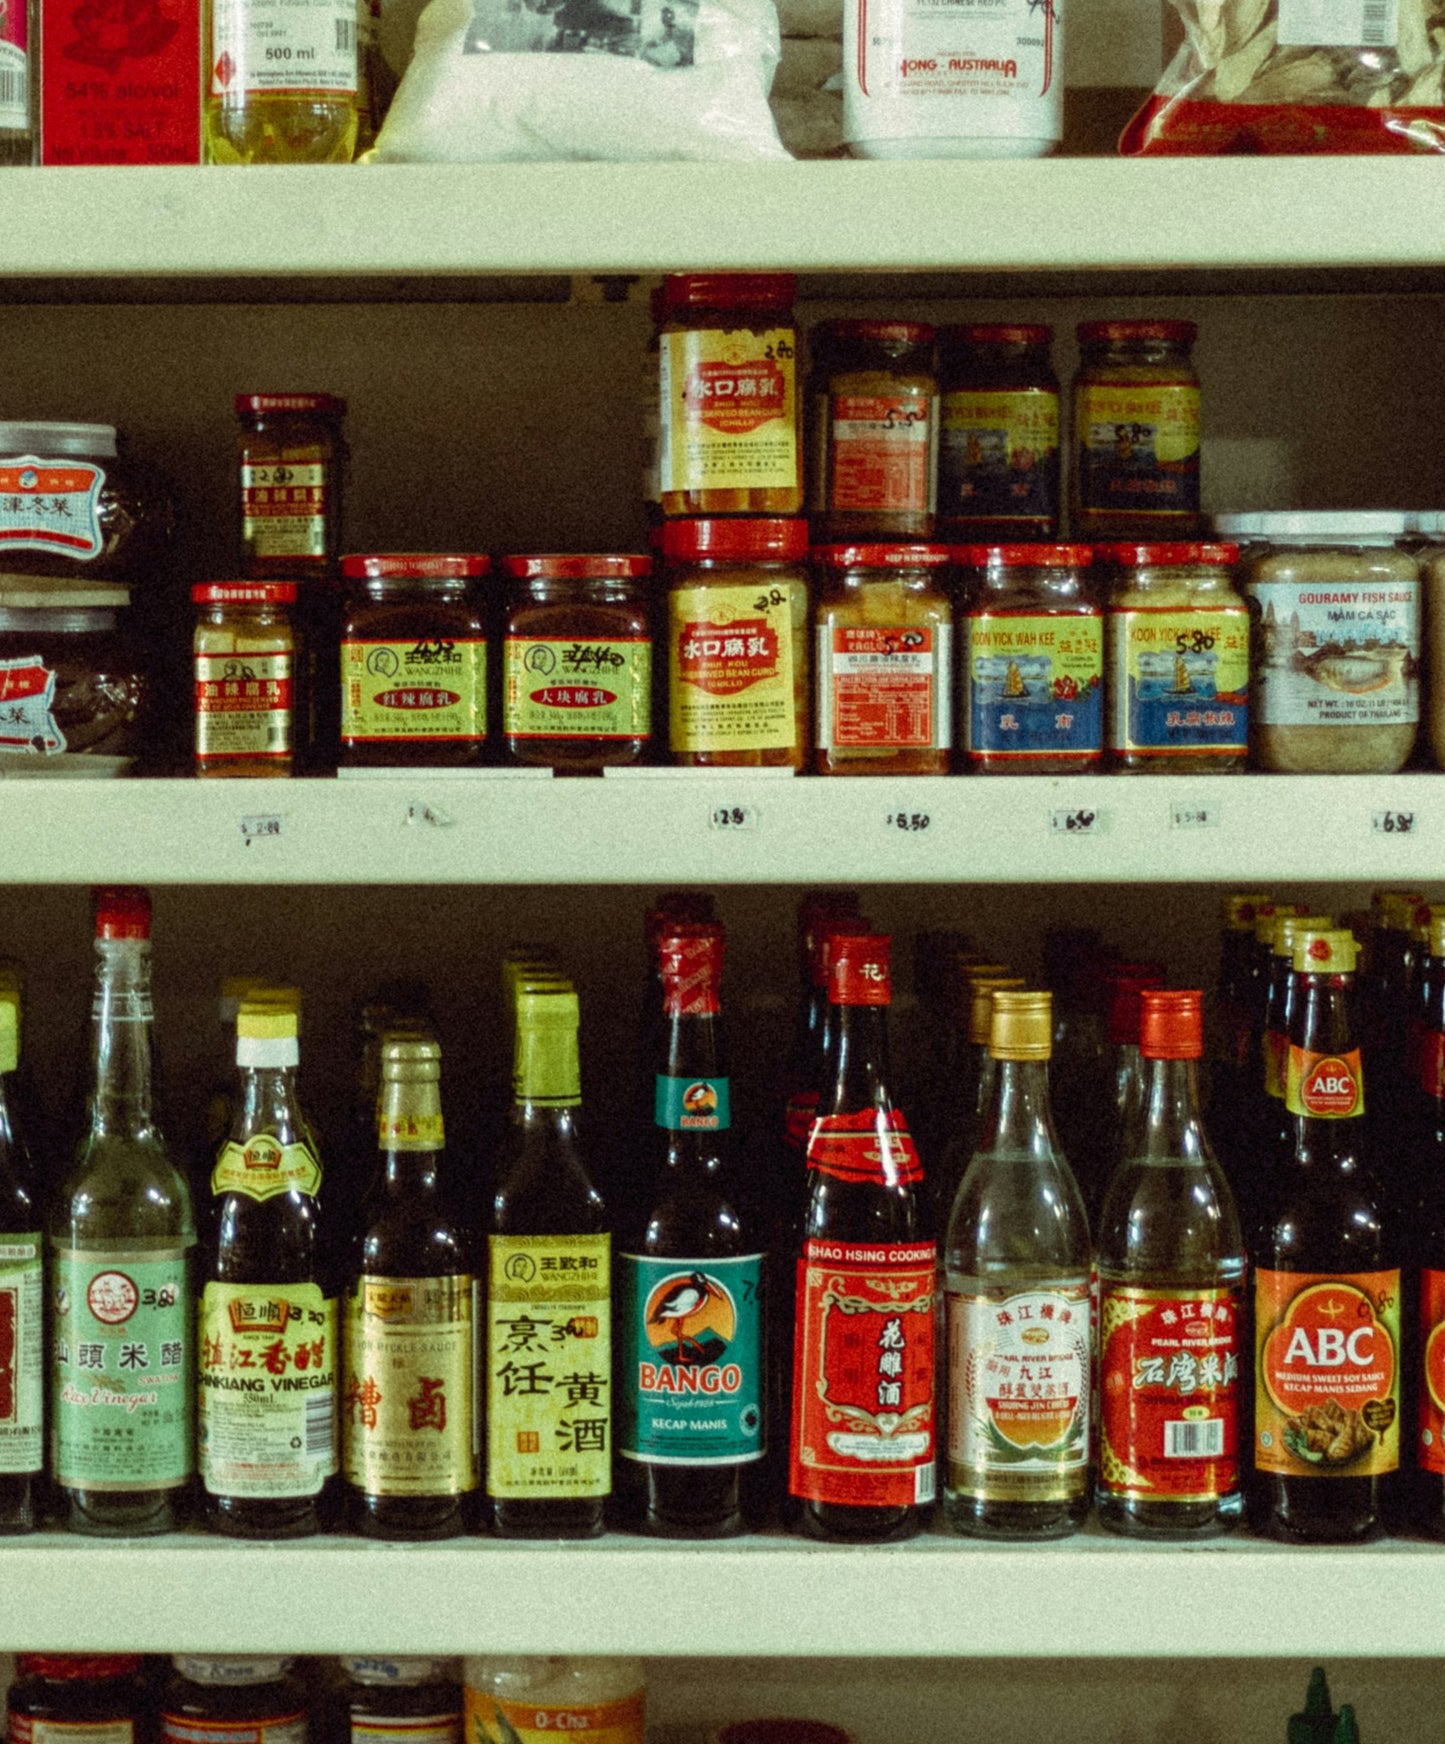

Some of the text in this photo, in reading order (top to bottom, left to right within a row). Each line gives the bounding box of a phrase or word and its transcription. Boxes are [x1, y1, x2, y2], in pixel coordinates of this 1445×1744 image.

[266, 47, 315, 60] 500 ml
[948, 59, 1018, 78] AUSTRALIA
[65, 81, 109, 99] 54%
[123, 121, 165, 140] SALT
[1299, 591, 1412, 604] GOURAMY FISH SAUCE
[993, 632, 1012, 645] YICK
[1016, 632, 1036, 645] WAH
[1039, 632, 1055, 645] KEE
[1131, 627, 1157, 641] KOON
[684, 637, 769, 659] 水口腐乳
[1176, 630, 1215, 655] 5.80
[726, 668, 750, 678] BEAN
[751, 667, 775, 677] CURD
[541, 690, 607, 704] 大块腐乳
[1319, 711, 1356, 719] PRODUCT
[1313, 1077, 1350, 1093] ABC
[680, 1115, 719, 1127] BANGO
[808, 1244, 843, 1260] SHAO
[845, 1247, 886, 1262] HSING
[540, 1256, 598, 1271] 王致和
[378, 1342, 416, 1354] PICKLE
[420, 1341, 457, 1353] SAUCE
[1151, 1338, 1180, 1347] PEARL
[1284, 1327, 1375, 1367] ABC
[495, 1315, 554, 1397] 烹饪
[878, 1318, 905, 1406] 花雕酒
[1021, 1353, 1047, 1362] RIVER
[639, 1363, 742, 1394] BANGO
[1020, 1365, 1052, 1381] 九江
[1275, 1372, 1385, 1383] MEDIUM SWEET SOY SAUCE
[271, 1373, 334, 1392] VINEGAR
[1283, 1383, 1378, 1393] KECAP MANIS SEDANG
[92, 1388, 156, 1411] Vinegar
[555, 1372, 608, 1453] 黄酒
[652, 1418, 728, 1430] KECAP MANIS
